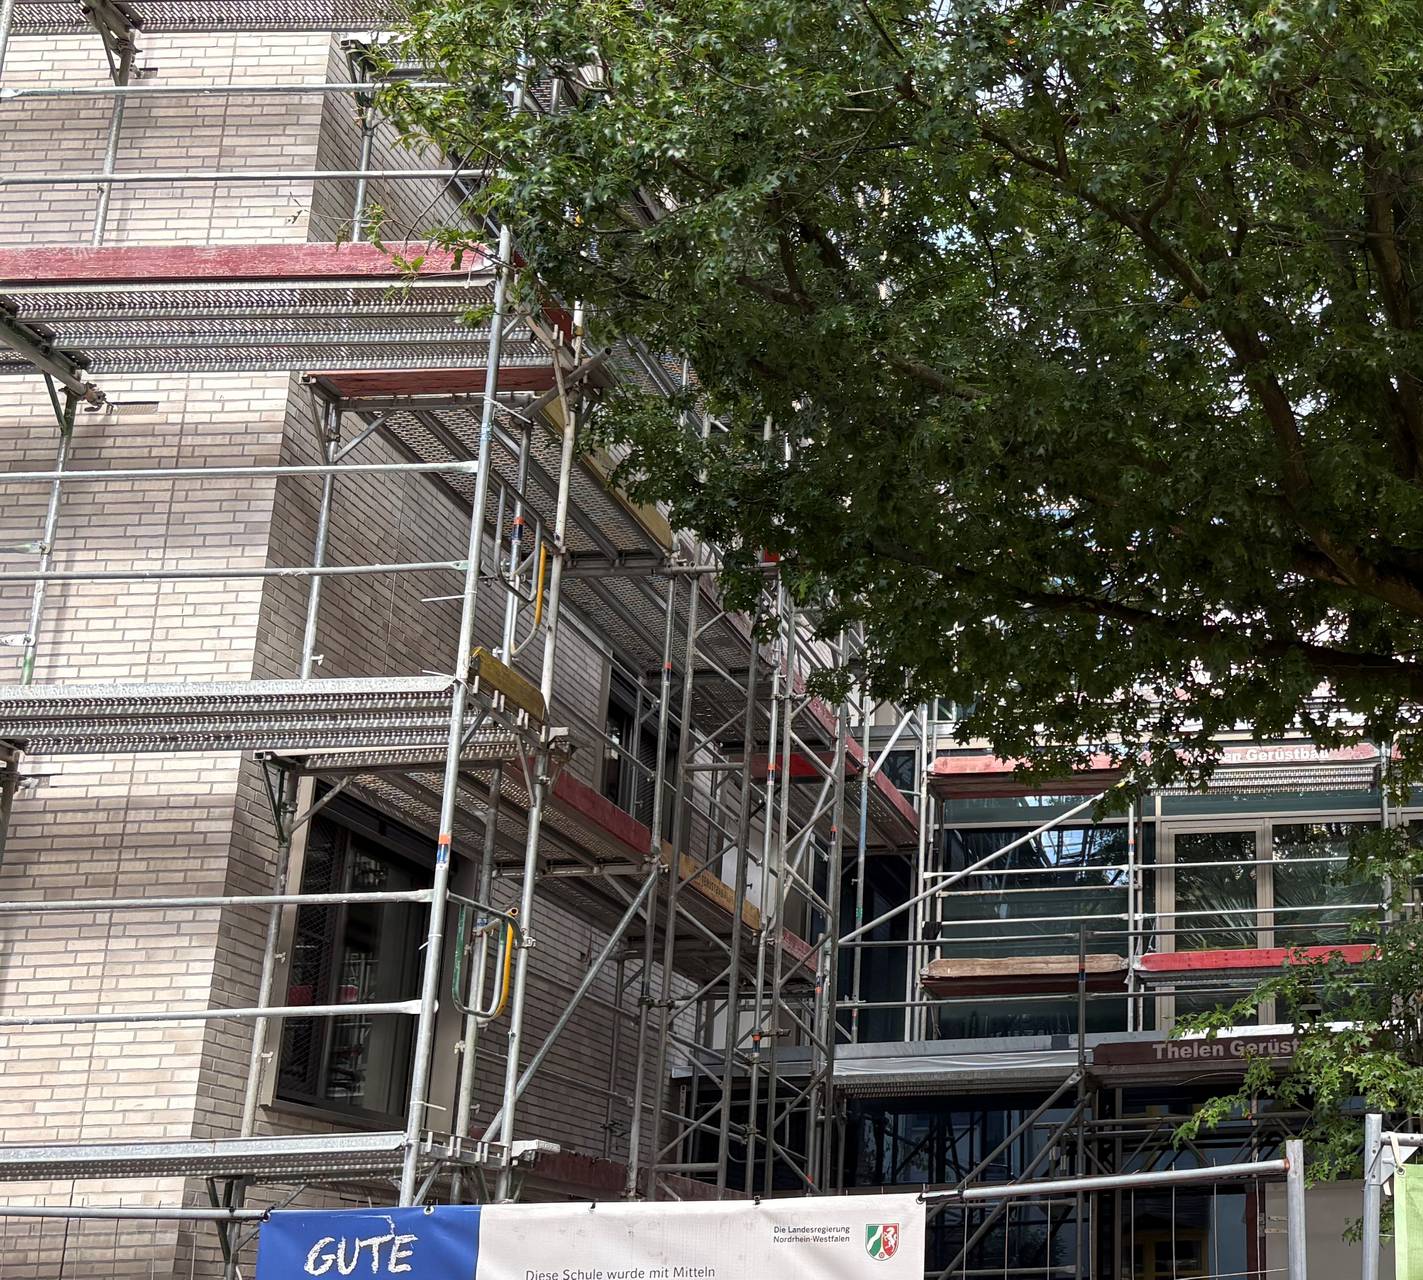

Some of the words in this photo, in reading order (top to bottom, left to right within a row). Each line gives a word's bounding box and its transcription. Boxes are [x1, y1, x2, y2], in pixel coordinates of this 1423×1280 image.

[1152, 1042, 1224, 1060] Thelen
[1230, 1039, 1300, 1056] Gerüst
[773, 1226, 786, 1234] Die
[788, 1225, 850, 1235] Landesregierung
[773, 1234, 850, 1243] Nordrhein-Westfalen
[303, 1233, 419, 1276] GUTE
[525, 1269, 559, 1280] Diese
[562, 1268, 603, 1280] Schule
[606, 1267, 645, 1280] wurde
[649, 1266, 669, 1279] mit
[673, 1265, 715, 1278] Mitteln
